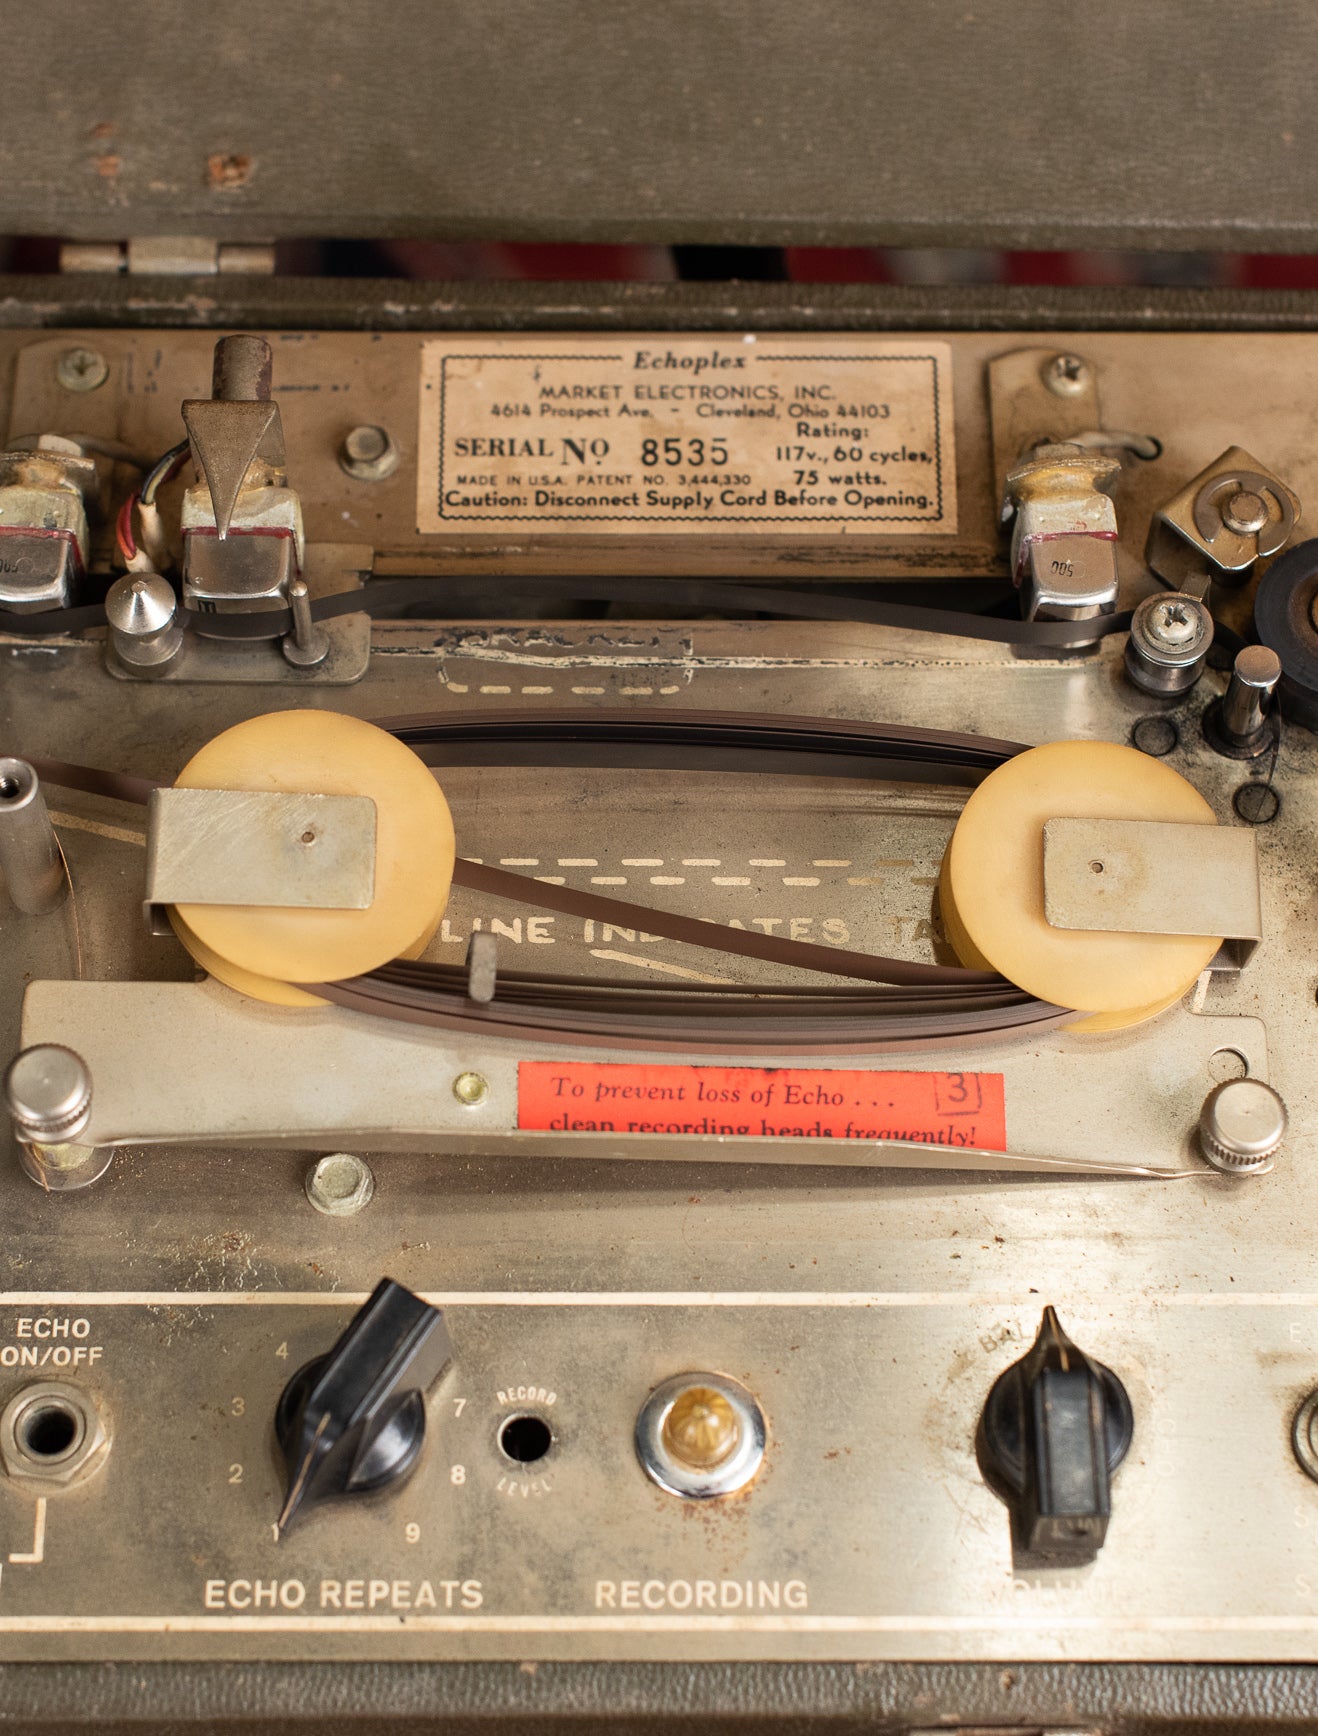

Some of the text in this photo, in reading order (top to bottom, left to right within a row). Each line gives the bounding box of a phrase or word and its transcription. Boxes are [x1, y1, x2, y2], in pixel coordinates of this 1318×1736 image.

[633, 350, 747, 375] Echoplex
[538, 385, 837, 402] MARKET ELECTRONICS, INC.
[491, 404, 532, 417] 4614
[540, 404, 610, 419] Prospect
[696, 403, 781, 420] Cleveland,
[788, 403, 829, 418] Ohio
[836, 404, 891, 419] 44103
[796, 421, 869, 440] Rating:
[454, 438, 554, 458] SERIAL
[641, 438, 729, 467] 8535
[833, 446, 863, 462] 60
[457, 476, 498, 486] MADE
[506, 476, 521, 486] IN
[577, 475, 633, 486] PATENT
[677, 474, 751, 487] 3,444,330
[793, 470, 887, 486] 75 watts.
[445, 489, 934, 510] Caution: Disconnect Supply Cord Before Opening.
[552, 1077, 585, 1097] To
[596, 1082, 685, 1101] prevent
[699, 1082, 740, 1102] loss
[751, 1084, 775, 1107] of
[947, 1073, 968, 1102] 3
[550, 1113, 615, 1131] clean
[17, 1318, 90, 1338] ECHO
[1, 1347, 103, 1367] ON/OFF
[276, 1343, 289, 1360] 4
[496, 1386, 557, 1406] RECORD
[231, 1398, 245, 1416] 3
[453, 1400, 467, 1417] 7
[228, 1465, 243, 1484] 2
[450, 1465, 466, 1485] 8
[496, 1477, 553, 1498] LEVEL
[406, 1523, 420, 1543] 9
[204, 1580, 485, 1609] ECHO REPEATS
[595, 1580, 808, 1609] RECORDING
